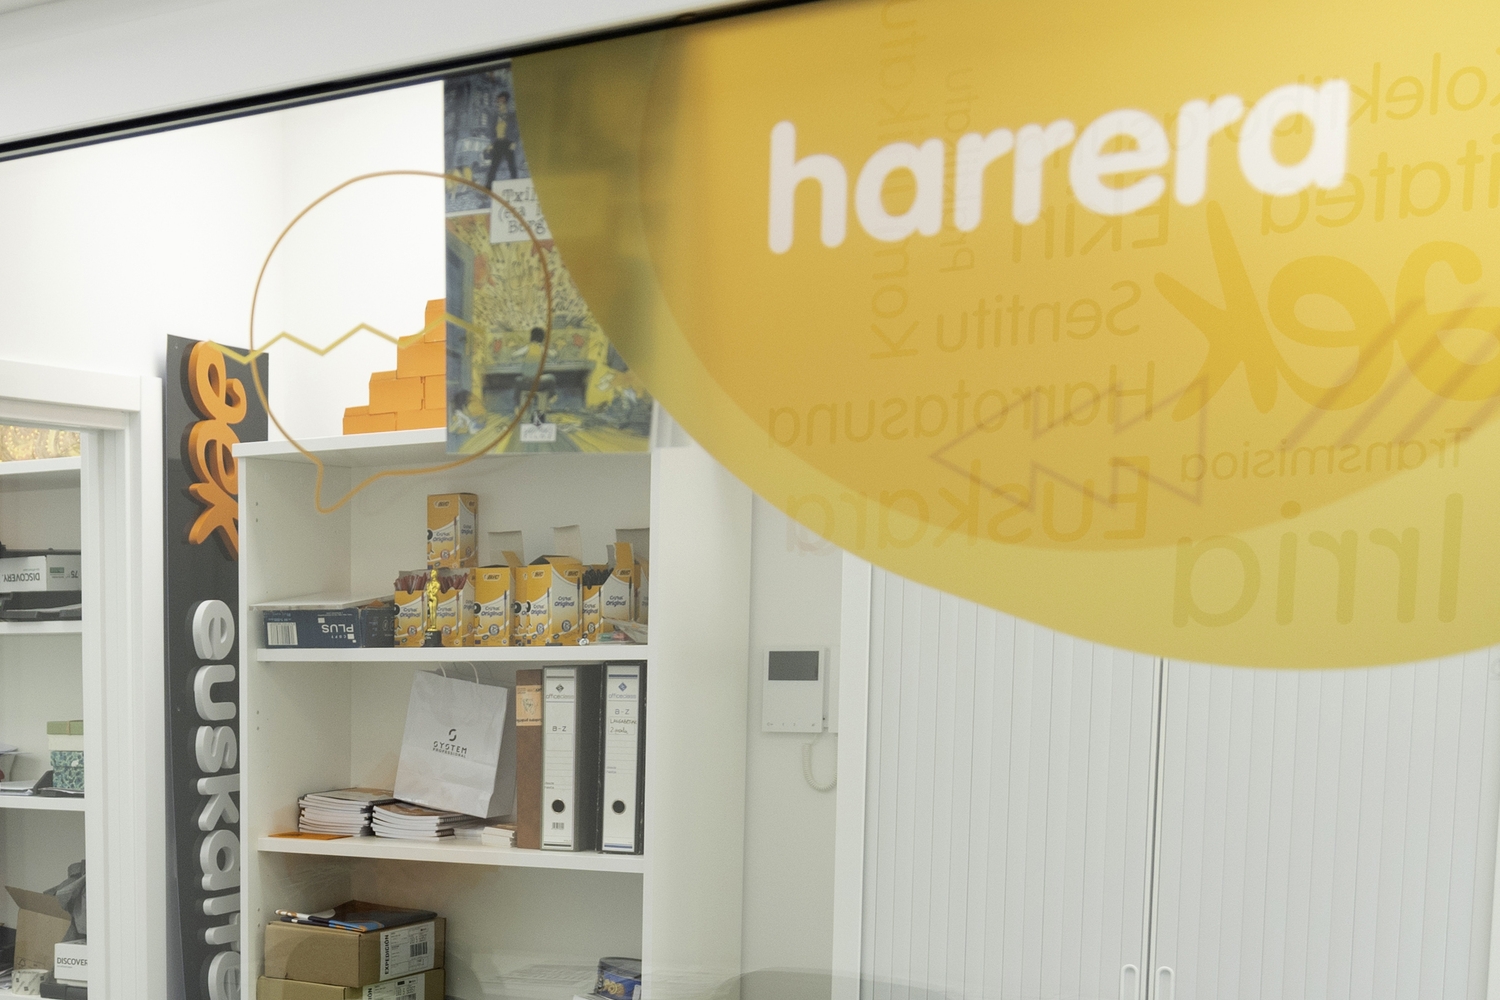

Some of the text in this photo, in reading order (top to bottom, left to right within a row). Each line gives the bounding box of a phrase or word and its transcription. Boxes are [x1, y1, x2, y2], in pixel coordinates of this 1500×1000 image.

[768, 79, 1350, 254] harrera
[182, 340, 247, 562] aek
[321, 624, 354, 633] PLUS
[433, 741, 467, 755] SYSTEM
